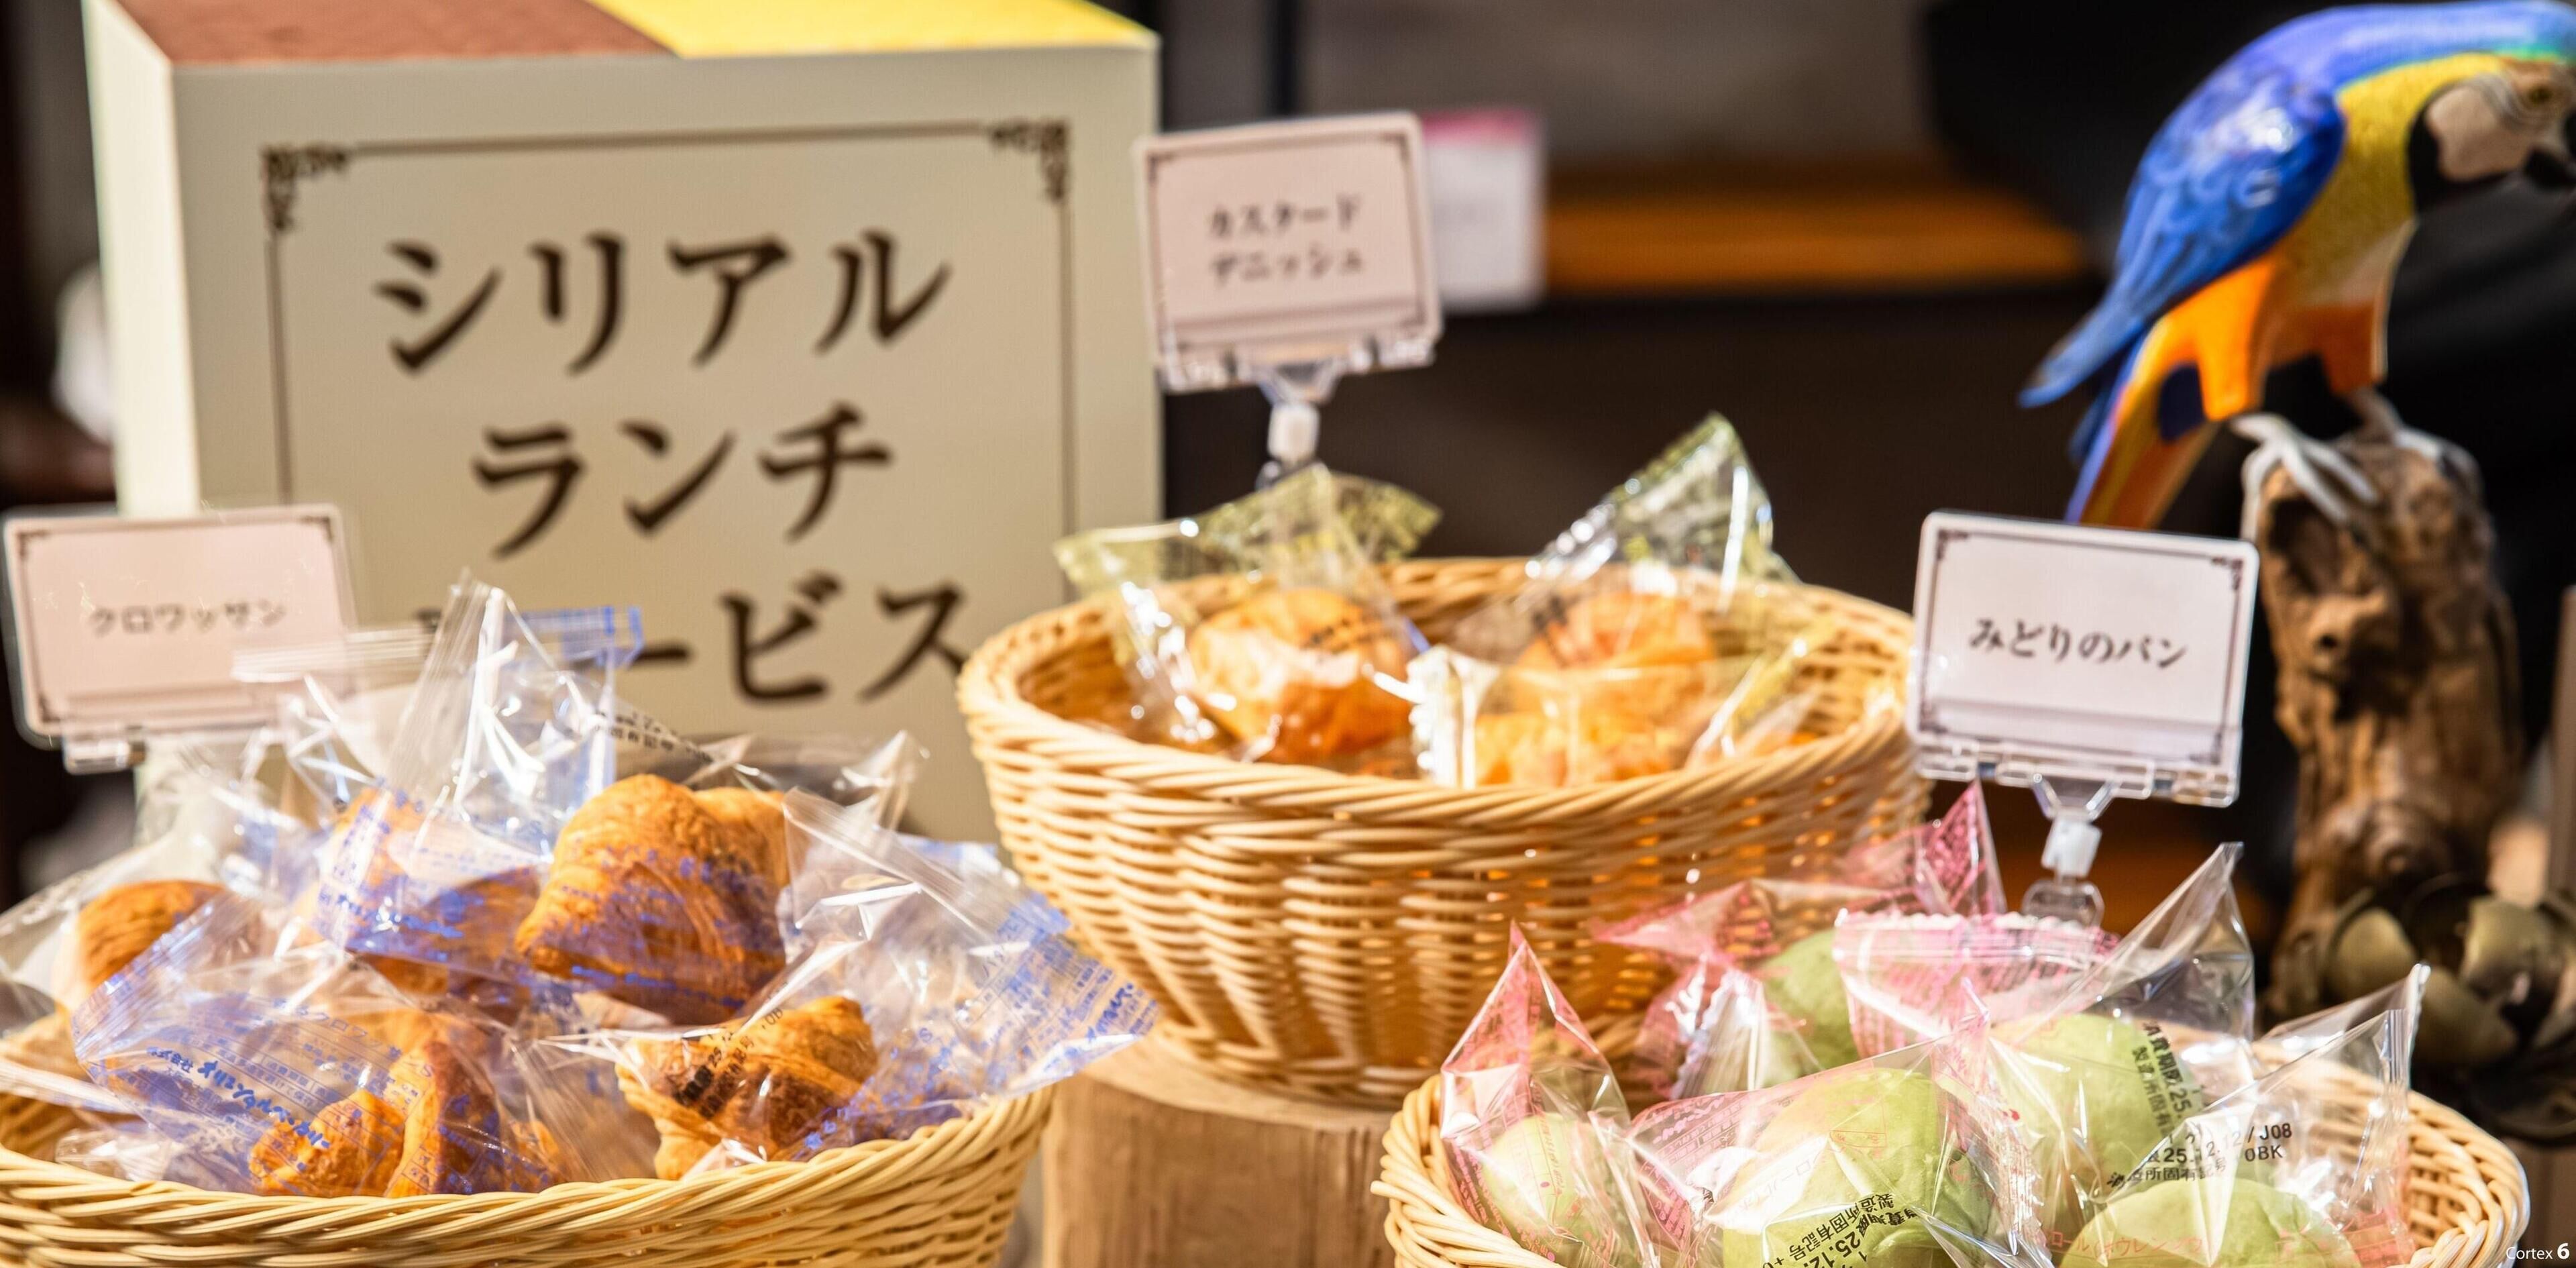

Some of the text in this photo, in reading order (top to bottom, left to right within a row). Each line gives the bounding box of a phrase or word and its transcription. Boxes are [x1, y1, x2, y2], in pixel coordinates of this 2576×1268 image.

[371, 229, 954, 376] シリアル
[468, 403, 896, 562] ランチ
[91, 599, 287, 637] クロワッサン
[564, 574, 970, 708] ービス
[1969, 617, 2189, 670] みどりのパン
